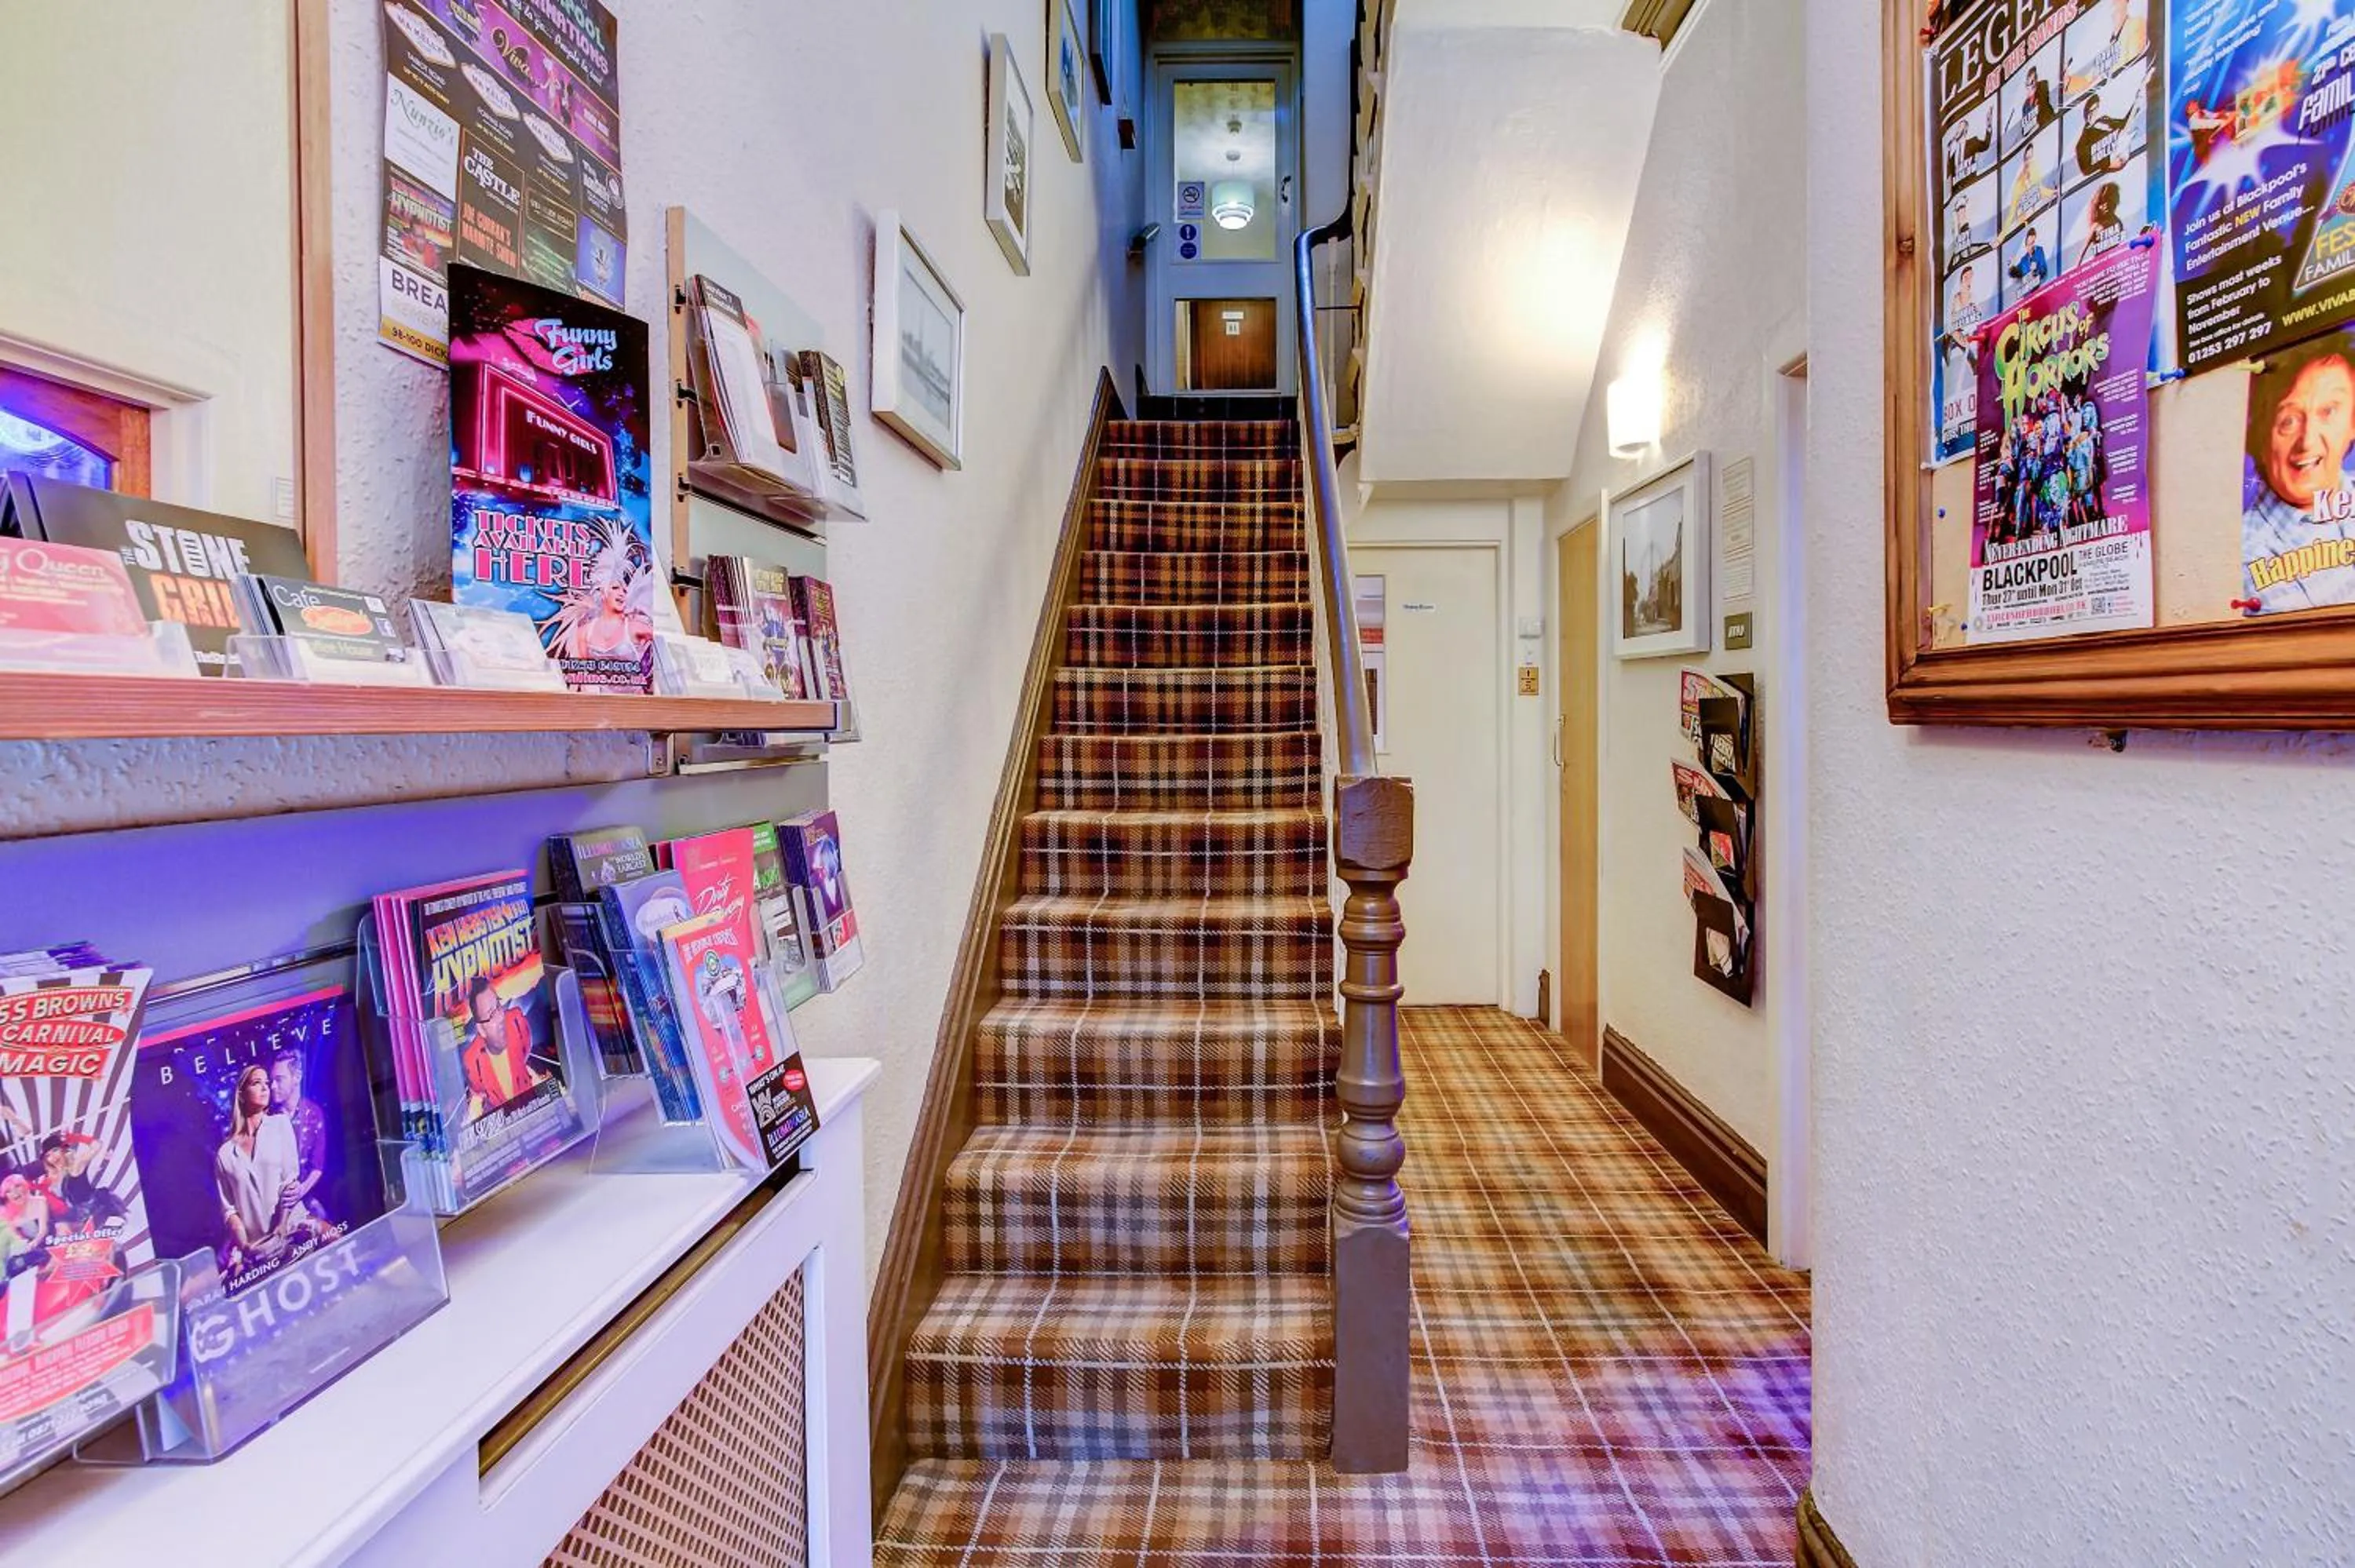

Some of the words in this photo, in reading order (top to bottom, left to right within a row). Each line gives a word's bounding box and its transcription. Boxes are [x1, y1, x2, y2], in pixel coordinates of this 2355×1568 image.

[465, 155, 520, 206] CASTLE
[472, 147, 494, 170] THE
[2185, 216, 2206, 235] Join
[2208, 209, 2221, 224] us
[2223, 199, 2235, 215] at
[2236, 162, 2307, 208] Blackpool's
[2185, 221, 2233, 253] Fantastic
[2235, 204, 2261, 228] NEW
[2263, 184, 2305, 214] Family
[2185, 224, 2260, 271] Entertainment
[2305, 249, 2354, 282] FAMIL
[392, 269, 447, 314] BREA
[2186, 284, 2218, 305] Shows
[2218, 269, 2244, 290] most
[2246, 254, 2282, 278] weeks
[2187, 304, 2210, 320] from
[2211, 283, 2255, 310] February
[2258, 277, 2270, 290] to
[534, 318, 617, 352] Funny
[1995, 301, 2079, 380] CIRCUS
[2188, 305, 2240, 335] November
[552, 343, 614, 376] Girls
[2189, 343, 2221, 364] 01253
[2225, 332, 2245, 350] 297
[2249, 321, 2272, 340] 297
[1998, 331, 2112, 418] HORRORS
[526, 409, 568, 445] FUNNY
[569, 432, 597, 455] GIRLS
[474, 510, 591, 543] TICKETS
[474, 531, 591, 554] AVAILABLE
[475, 549, 593, 590] HERE
[1983, 552, 2077, 592] BLACKPOOL
[2095, 542, 2128, 558] GLOBE
[2248, 538, 2355, 592] Happine
[2017, 585, 2037, 600] until
[2039, 584, 2057, 597] Mon
[433, 916, 535, 994] HYPNOTIST
[32, 990, 126, 1019] BROWNS
[2, 1023, 115, 1045] CARNIVAL
[161, 1018, 333, 1086] BELIEVE
[0, 1053, 102, 1075] MAGIC
[46, 1231, 89, 1246] Special
[229, 1257, 280, 1291] HARDING
[291, 1238, 319, 1259] ANDY
[322, 1220, 349, 1243] MOSS
[192, 1240, 360, 1364] GHOST
